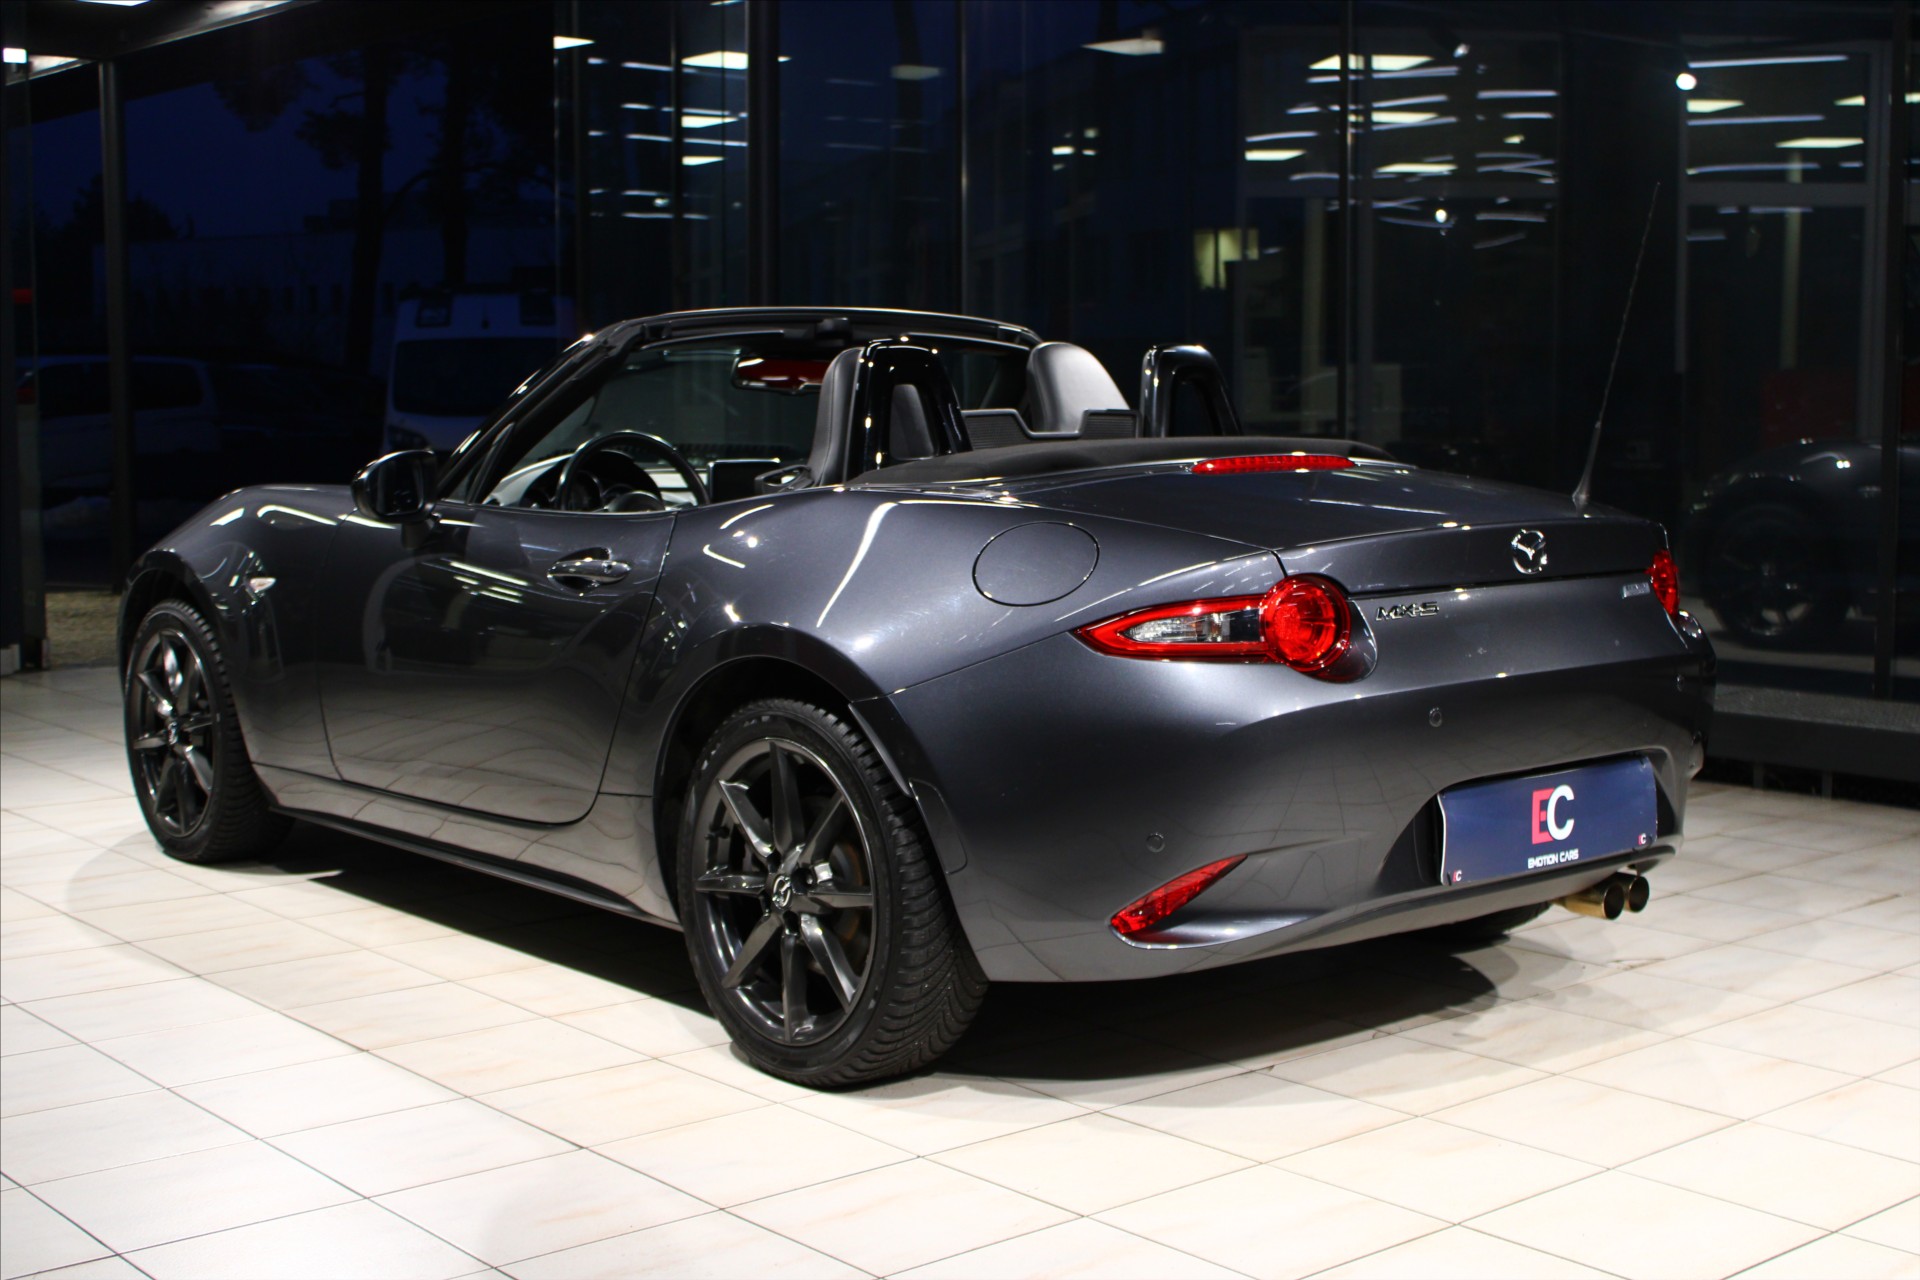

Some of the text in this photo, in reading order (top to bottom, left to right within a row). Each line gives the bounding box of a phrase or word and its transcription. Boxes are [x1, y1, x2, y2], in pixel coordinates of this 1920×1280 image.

[1531, 784, 1575, 844] EC
[1528, 848, 1579, 869] EMOTION CARS
